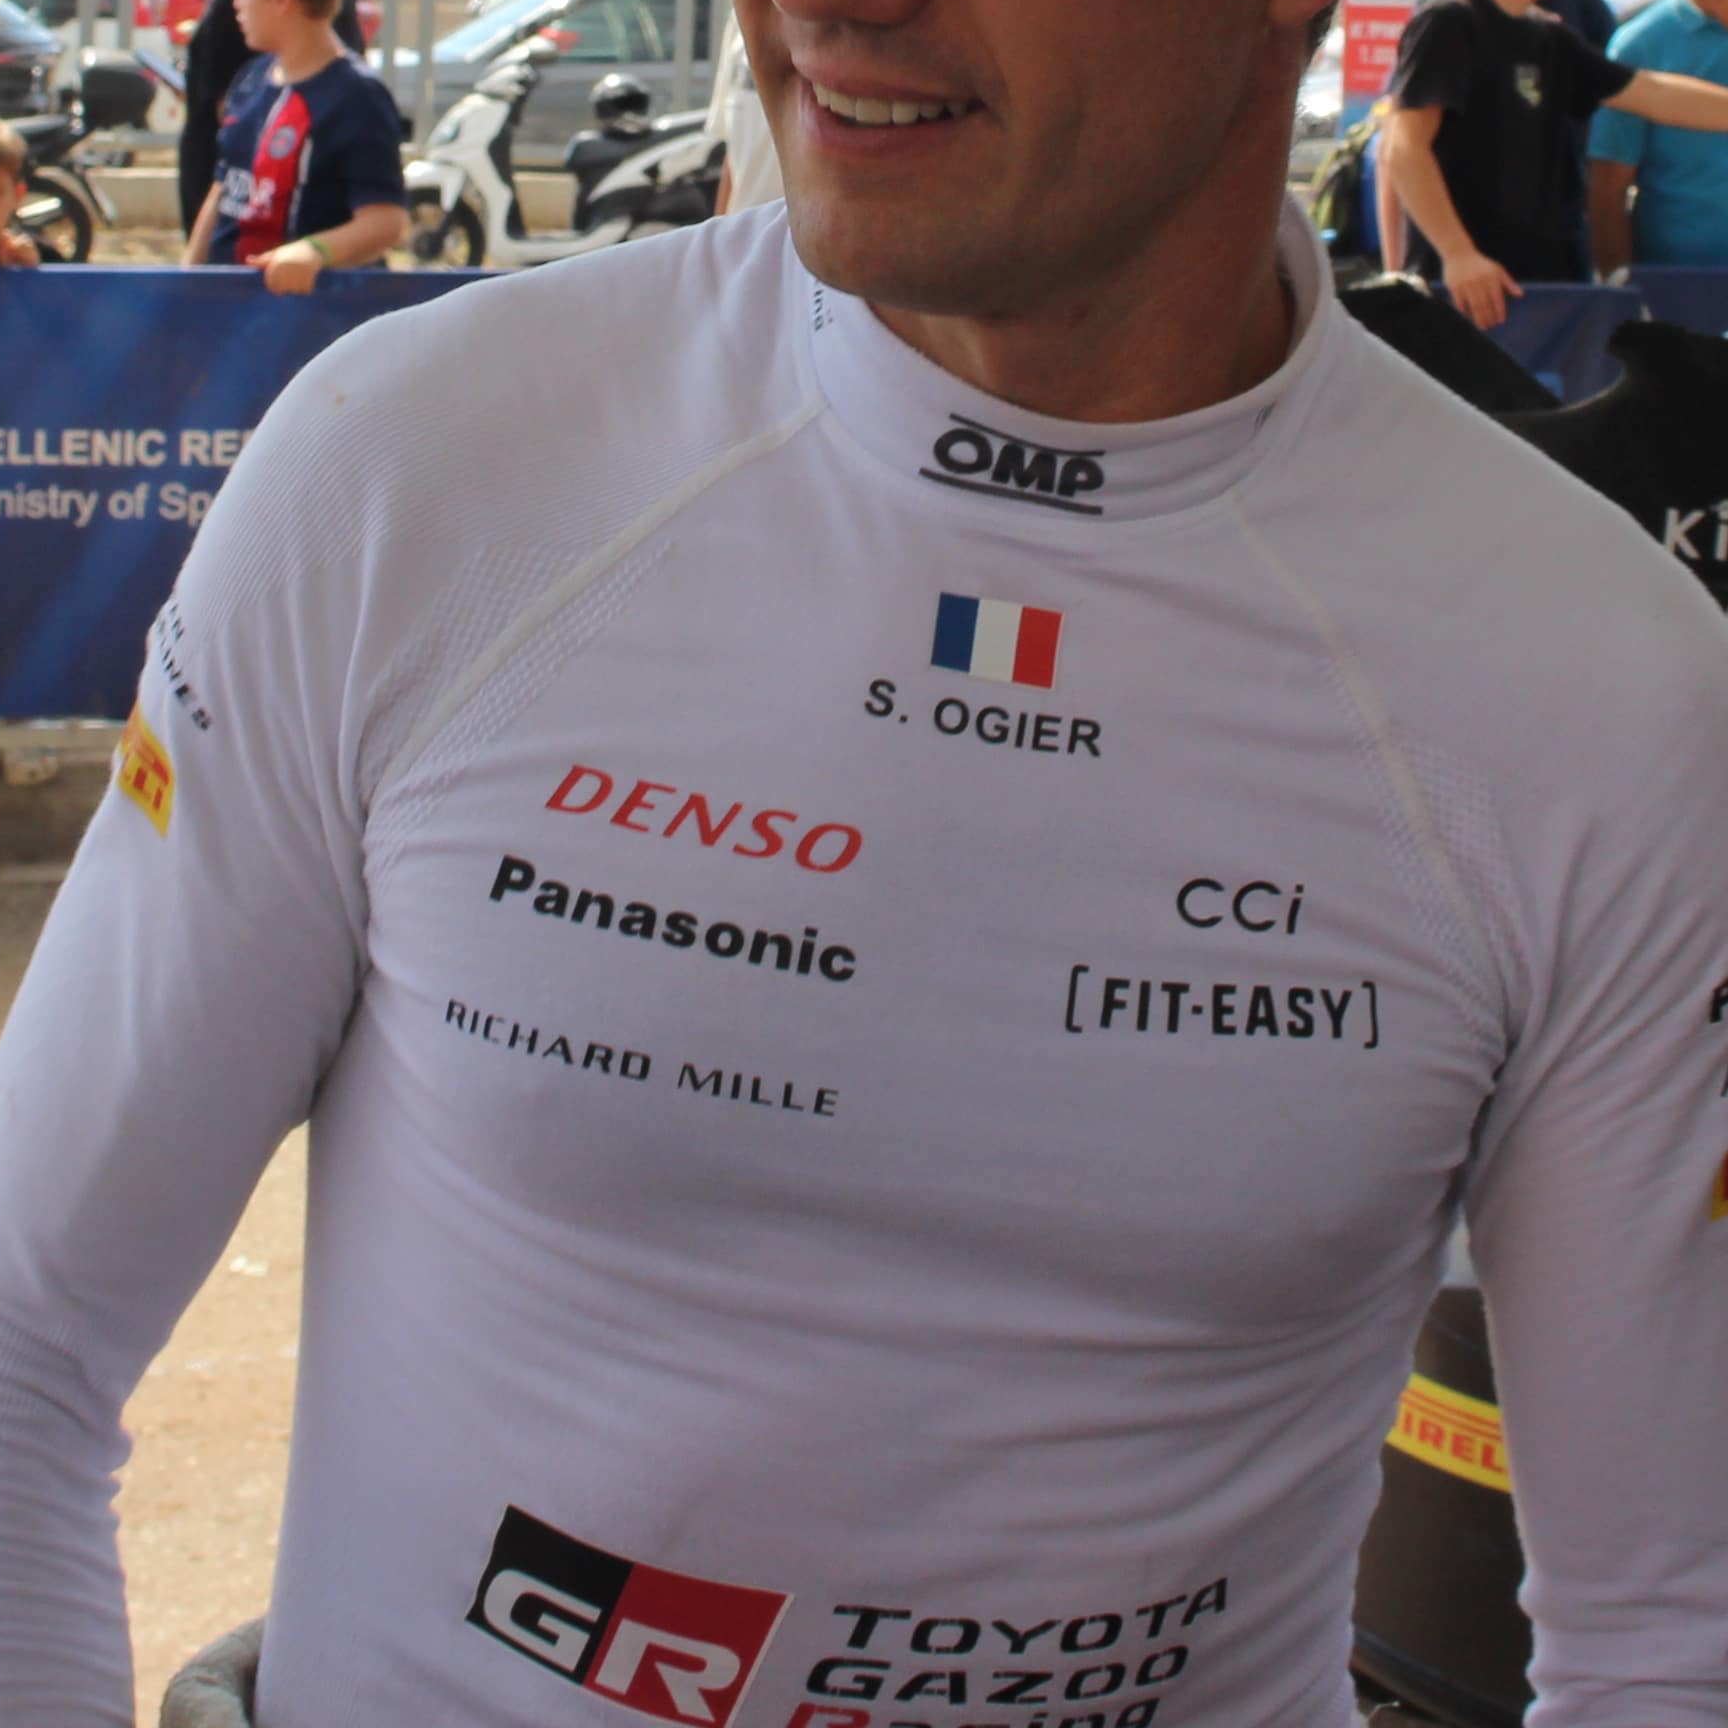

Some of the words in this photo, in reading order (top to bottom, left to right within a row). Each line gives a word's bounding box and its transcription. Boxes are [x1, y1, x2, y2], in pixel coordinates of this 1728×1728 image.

[933, 427, 1106, 498] OMP
[107, 481, 150, 520] of
[158, 482, 217, 528] Sp
[863, 678, 909, 724] S.
[933, 697, 1102, 758] OGIER
[544, 763, 864, 874] DENSO
[488, 854, 858, 983] Panasonic
[443, 998, 652, 1083] RICHARD
[677, 1062, 840, 1118] MILLE
[482, 1568, 741, 1726] GR
[832, 1576, 1229, 1655] TOYOTA
[805, 1644, 1190, 1705] GAZOO
